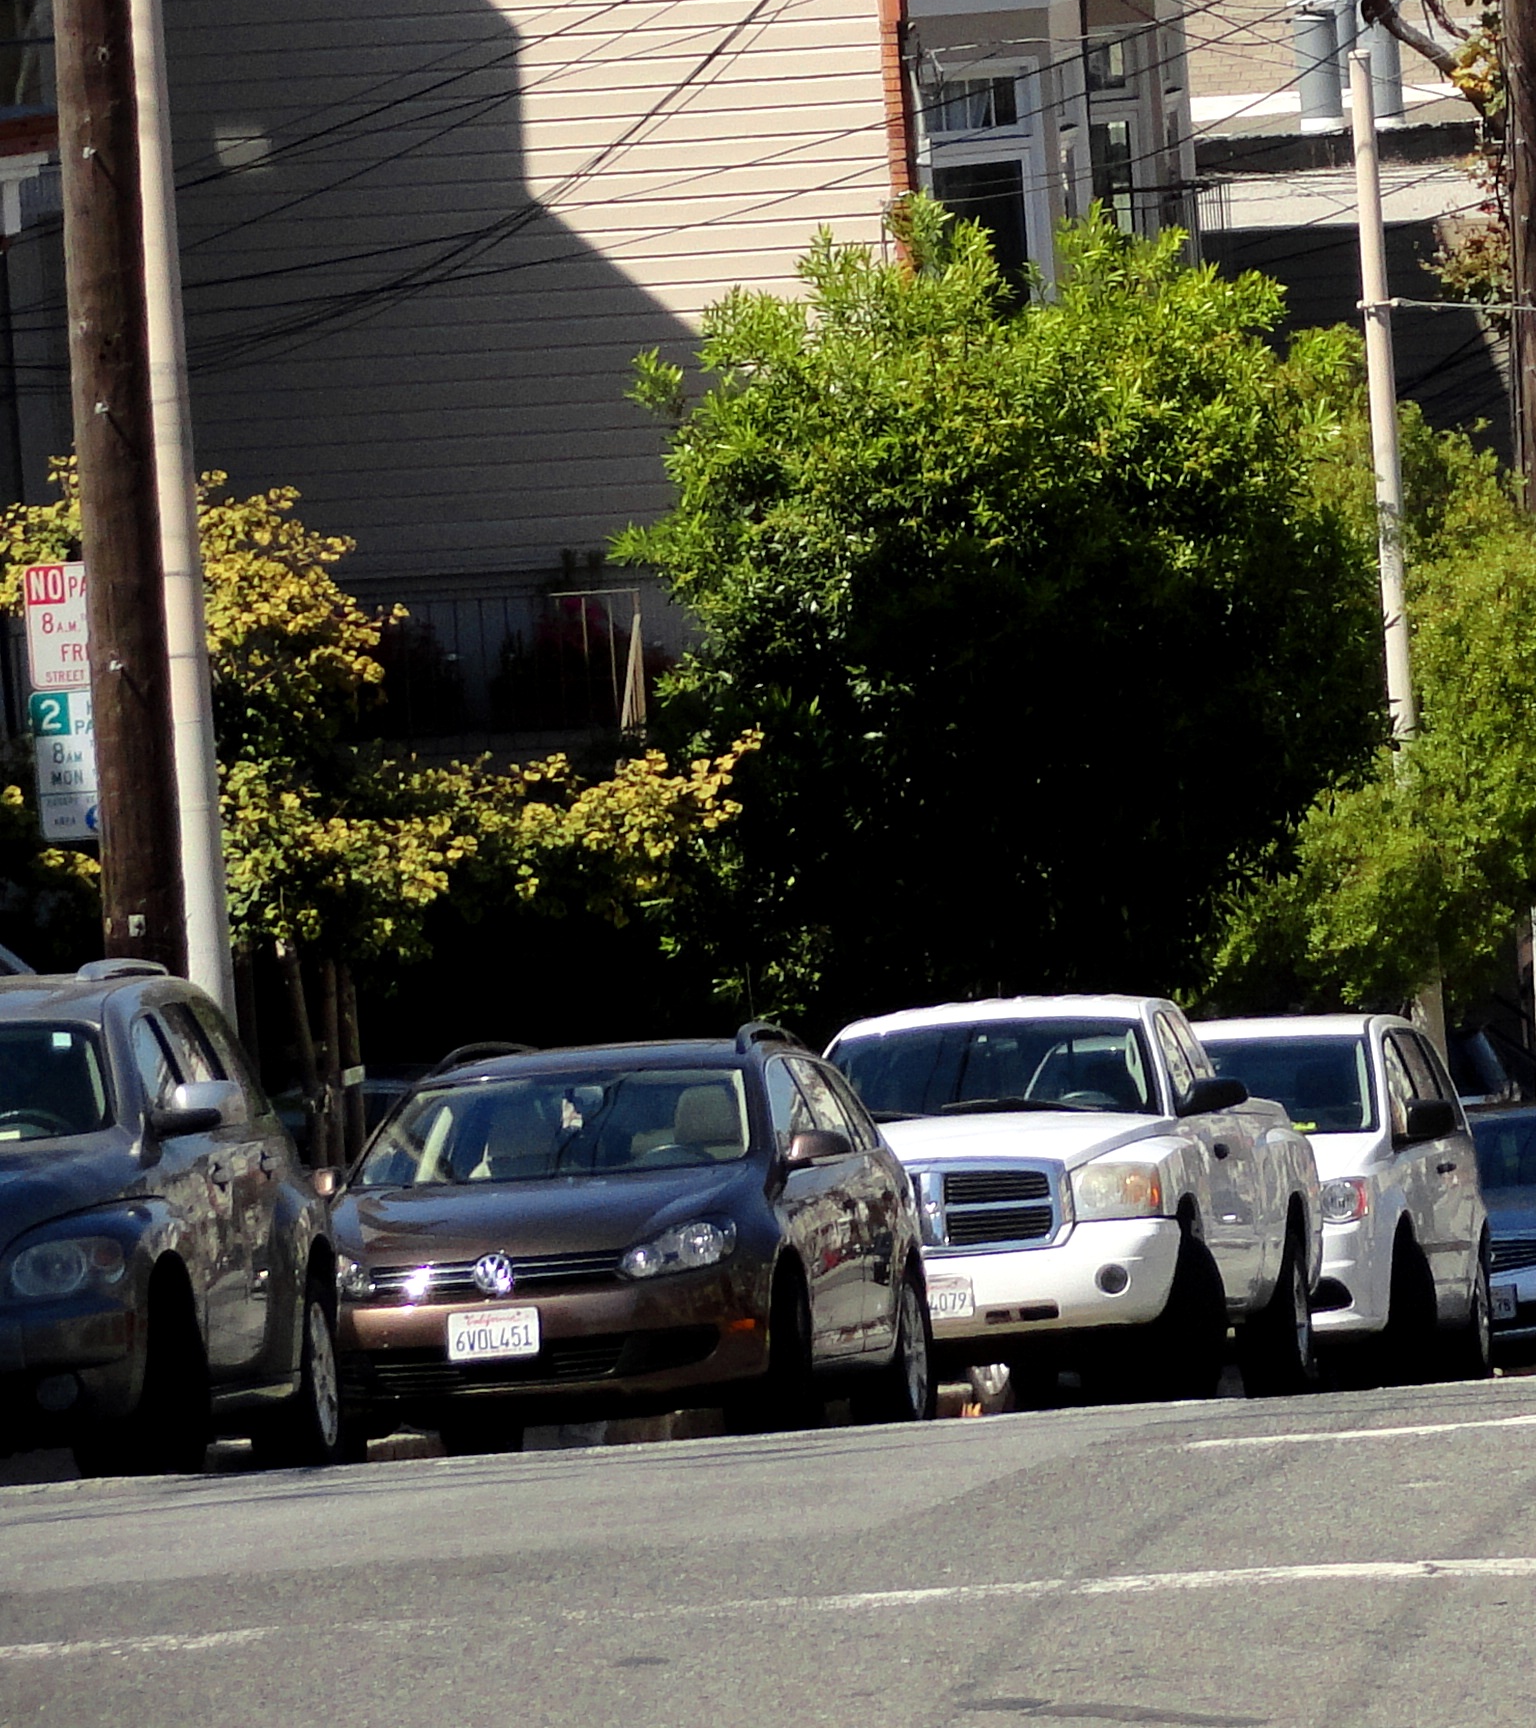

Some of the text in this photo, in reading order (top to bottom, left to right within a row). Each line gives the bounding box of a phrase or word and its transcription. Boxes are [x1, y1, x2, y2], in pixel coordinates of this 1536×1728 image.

[29, 569, 63, 602] NO
[45, 669, 85, 684] STREET
[40, 699, 62, 731] 2
[50, 770, 84, 786] MON
